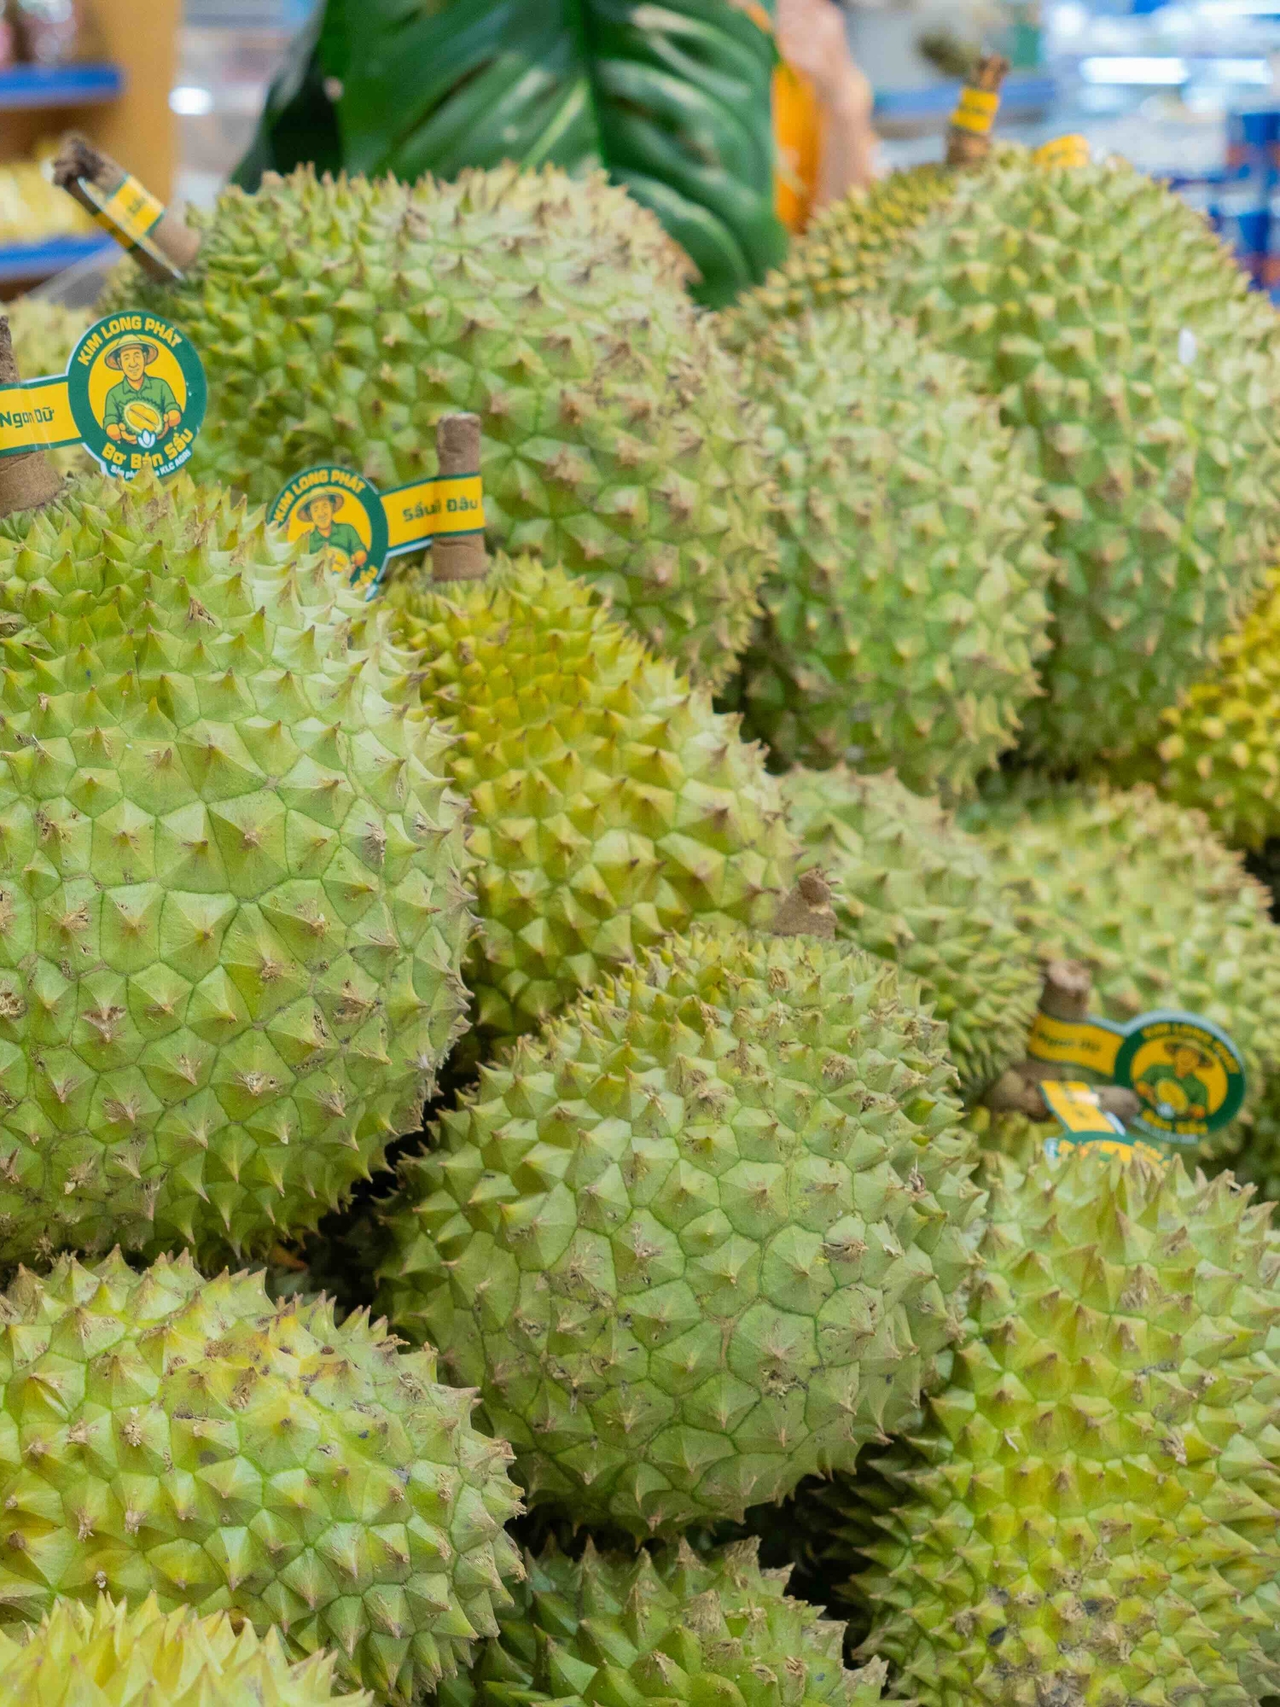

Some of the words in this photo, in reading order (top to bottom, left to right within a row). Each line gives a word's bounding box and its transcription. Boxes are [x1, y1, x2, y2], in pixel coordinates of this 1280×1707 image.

[77, 332, 103, 366] KIM
[100, 315, 142, 340] LONG
[144, 317, 183, 348] PHÁT
[174, 448, 192, 467] AGRI
[273, 490, 295, 522] KIM
[292, 468, 329, 495] LONG
